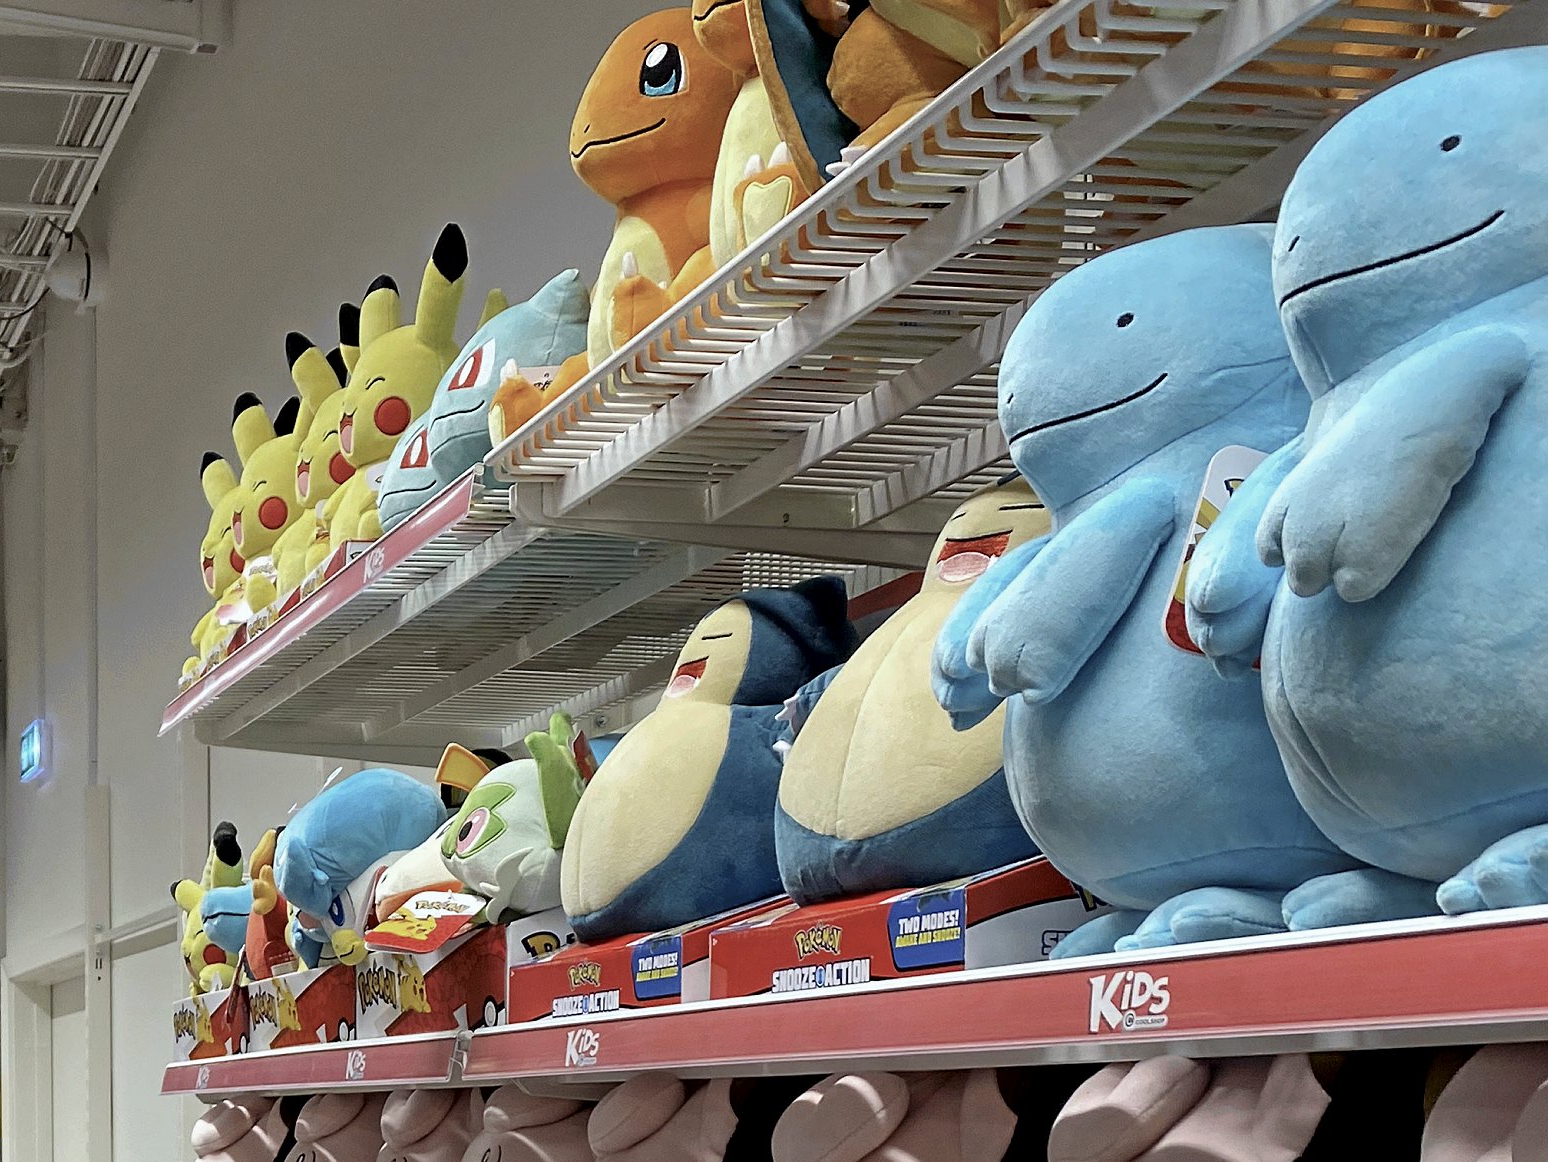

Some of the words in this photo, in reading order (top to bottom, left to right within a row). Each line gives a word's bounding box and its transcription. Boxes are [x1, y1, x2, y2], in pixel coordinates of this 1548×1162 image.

[898, 916, 920, 934] TWO
[921, 909, 961, 932] MODES!
[771, 968, 816, 994] SNOOZE
[824, 957, 871, 987] ACTION
[553, 996, 584, 1018] SNOOZE
[588, 989, 620, 1013] ACTION
